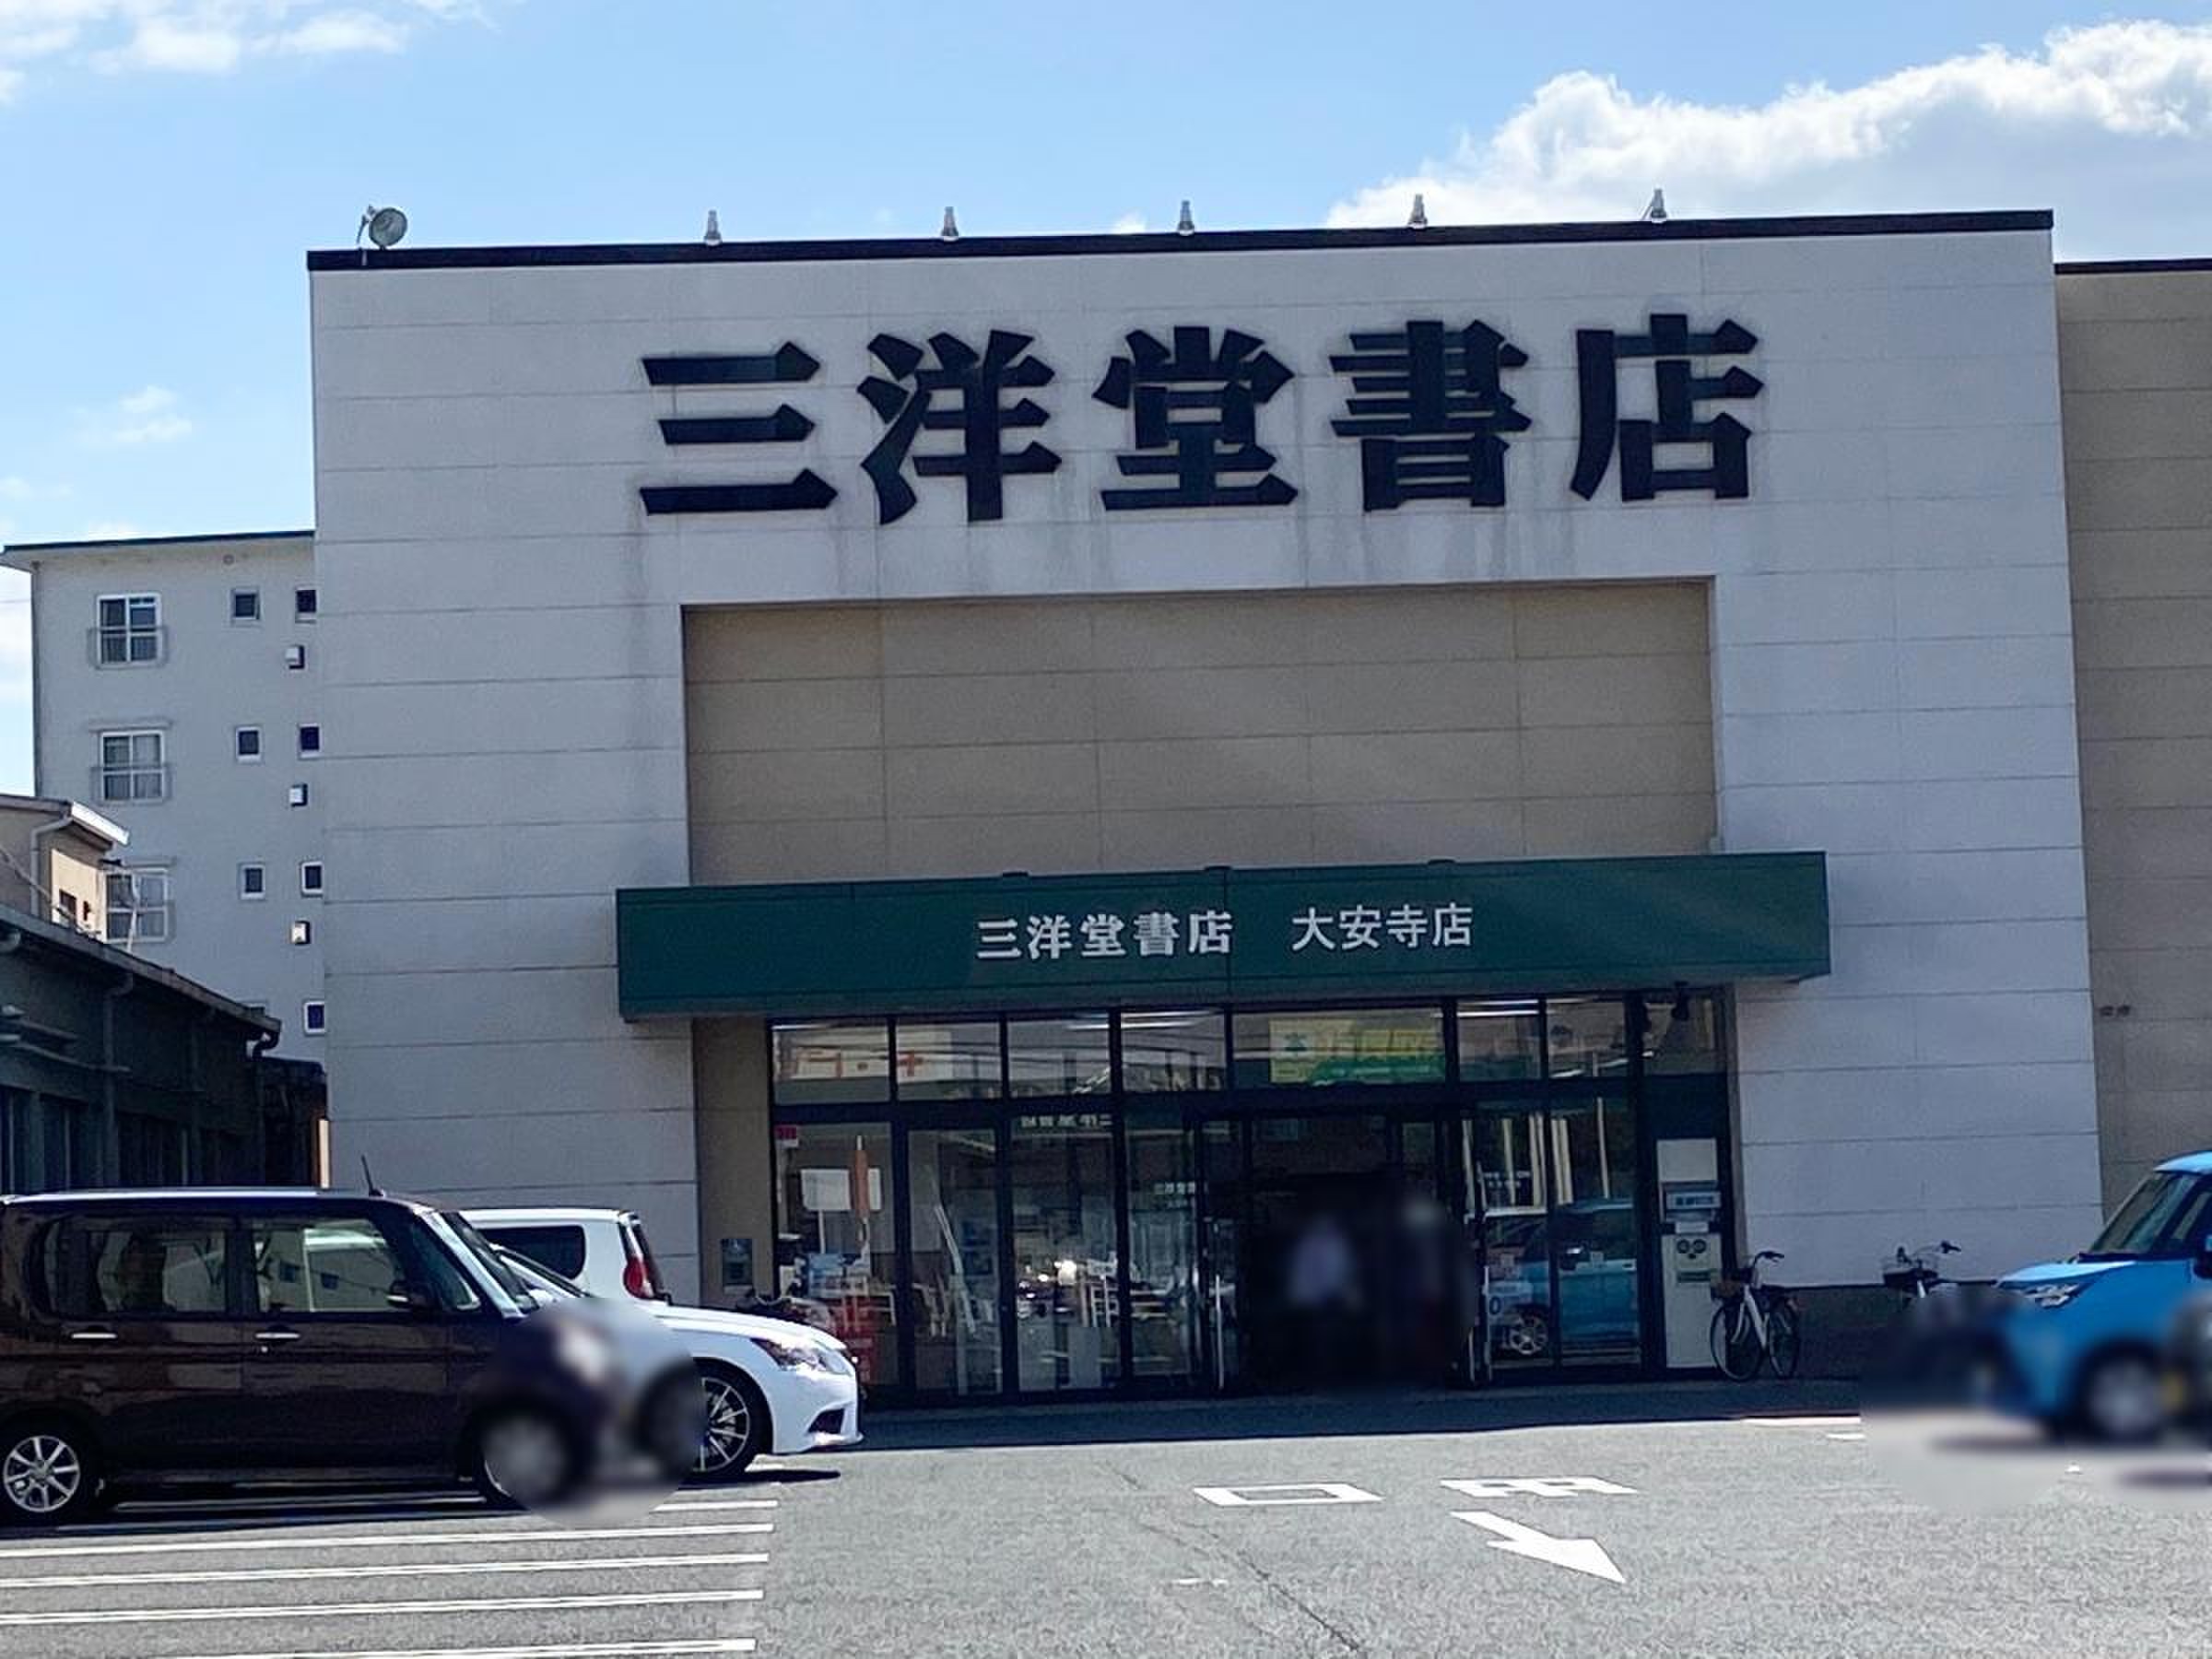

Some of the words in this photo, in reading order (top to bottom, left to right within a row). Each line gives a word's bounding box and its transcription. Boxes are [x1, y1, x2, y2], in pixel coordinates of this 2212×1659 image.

[640, 313, 1764, 524] 三洋堂書店
[976, 910, 1233, 960] 三洋堂書店
[1291, 902, 1473, 951] 大安寺店
